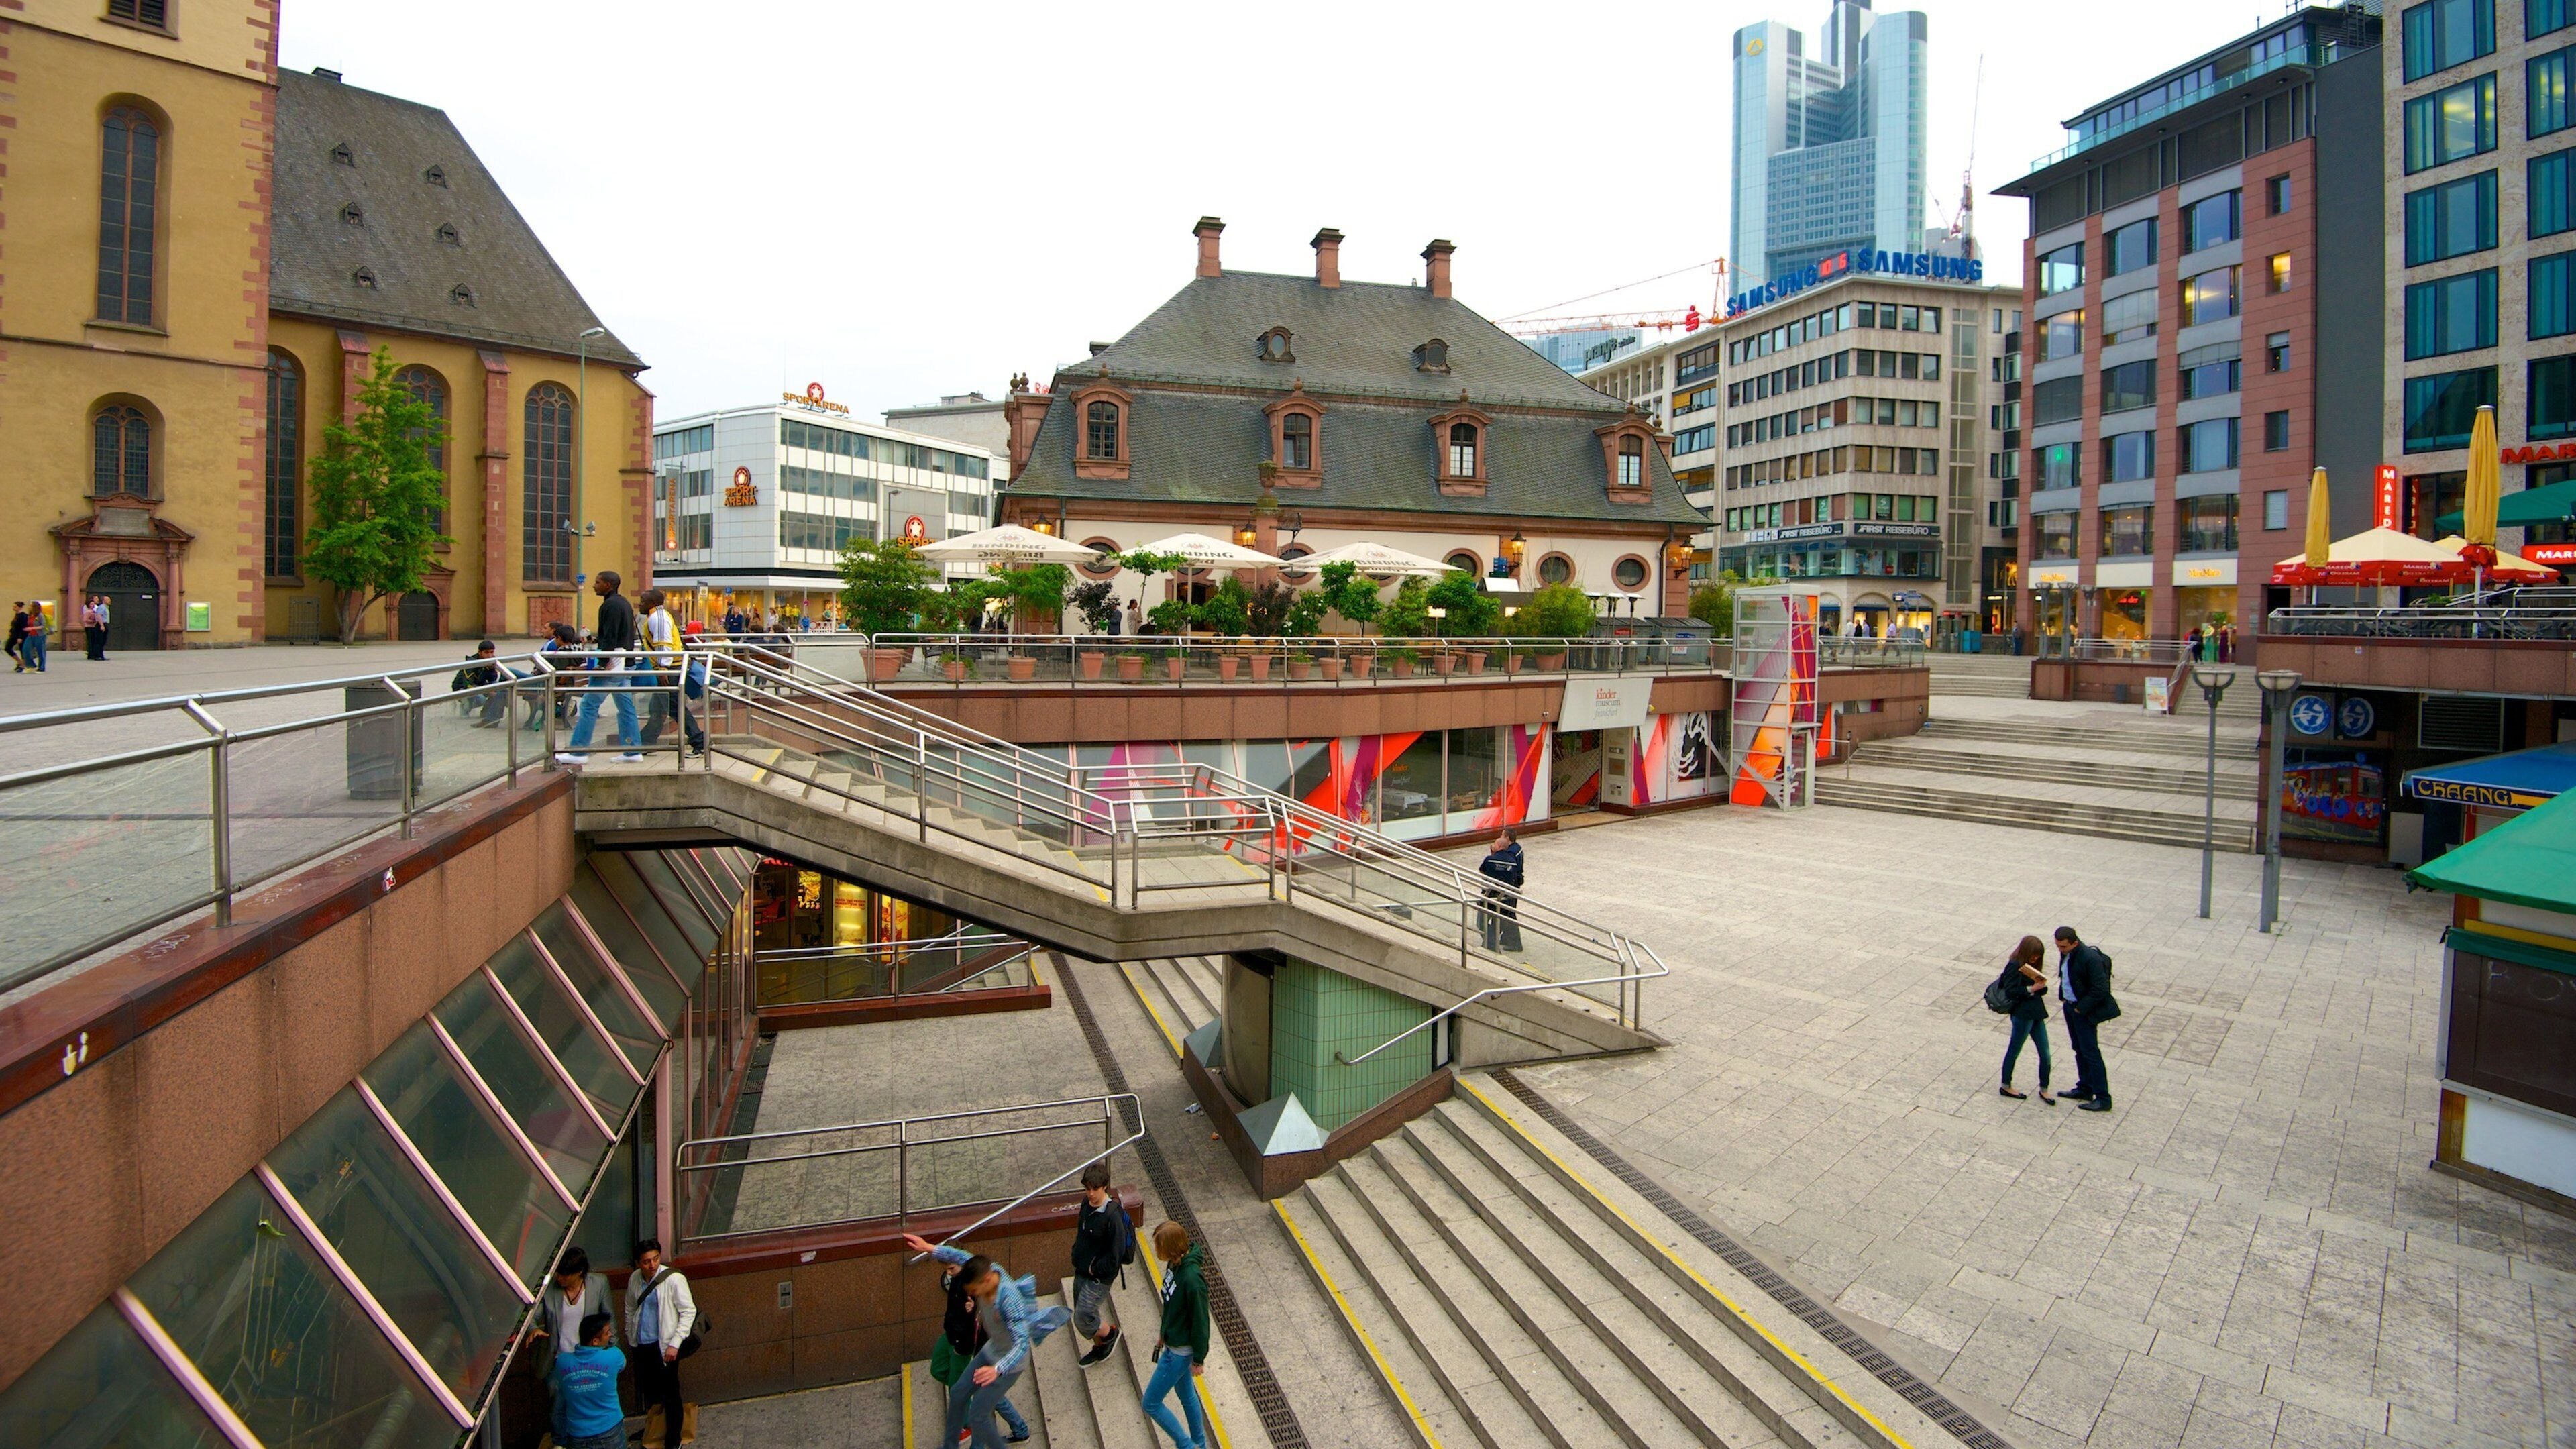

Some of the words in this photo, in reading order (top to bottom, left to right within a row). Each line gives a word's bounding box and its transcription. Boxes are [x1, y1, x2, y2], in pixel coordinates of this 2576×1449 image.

[1858, 248, 1983, 280] SAMSUNG
[1727, 264, 1817, 317] SAMSUNG
[1584, 338, 1617, 370] prange
[783, 392, 849, 414] SPORTARENA
[724, 496, 757, 507] ARENA
[1799, 525, 1833, 537] REISEBÜRO
[1885, 525, 1929, 535] REISEBÜRO
[1163, 550, 1234, 558] BINDING
[1596, 688, 1617, 700] kinder
[1596, 699, 1621, 707] museum
[2418, 780, 2508, 806] CHAANG
